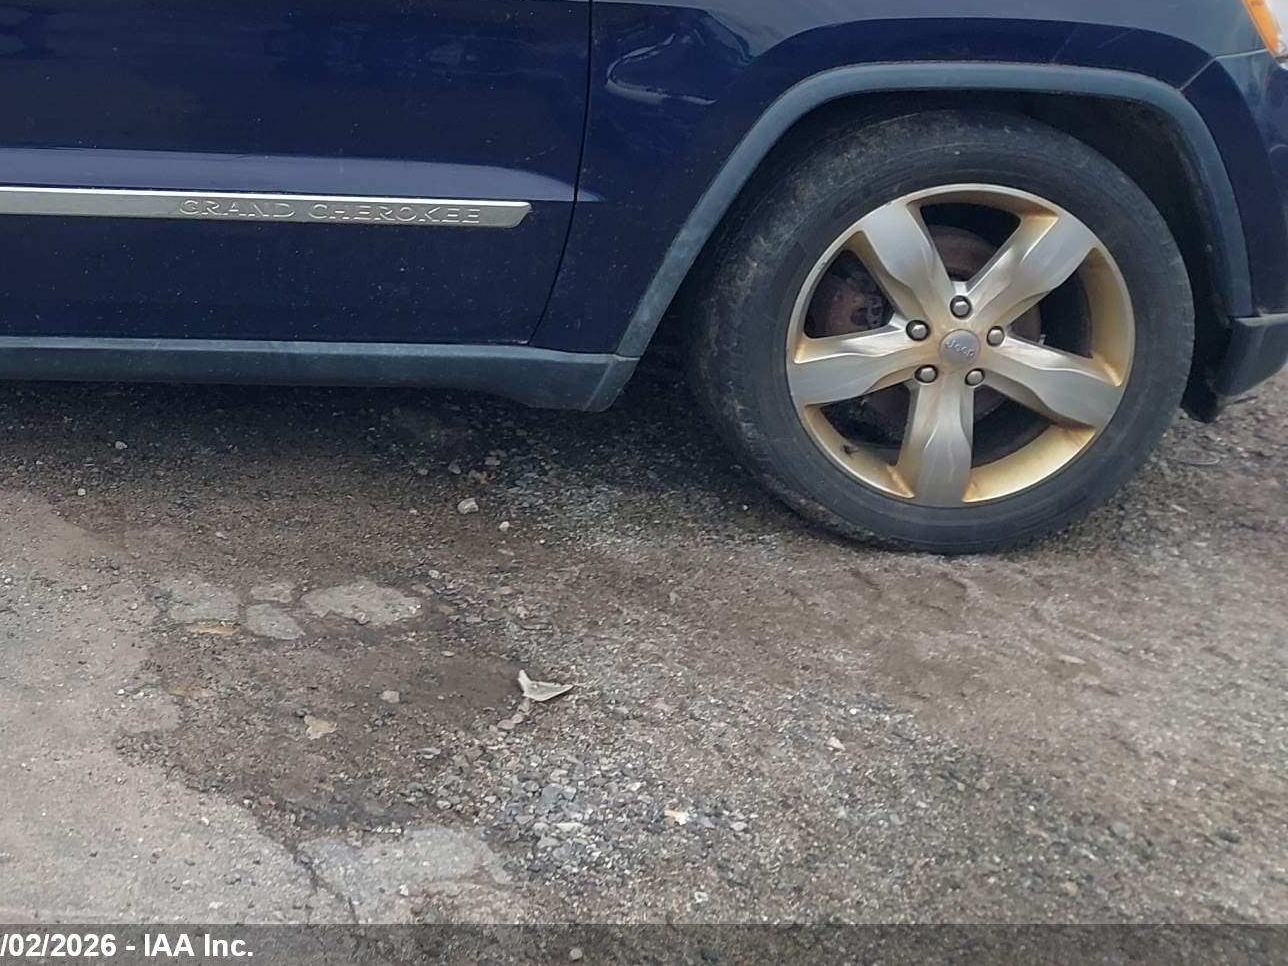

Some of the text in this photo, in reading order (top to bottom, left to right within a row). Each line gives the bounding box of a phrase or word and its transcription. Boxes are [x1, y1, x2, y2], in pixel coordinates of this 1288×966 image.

[179, 199, 481, 224] GRAND CHEROKEE
[945, 339, 976, 360] Jeep
